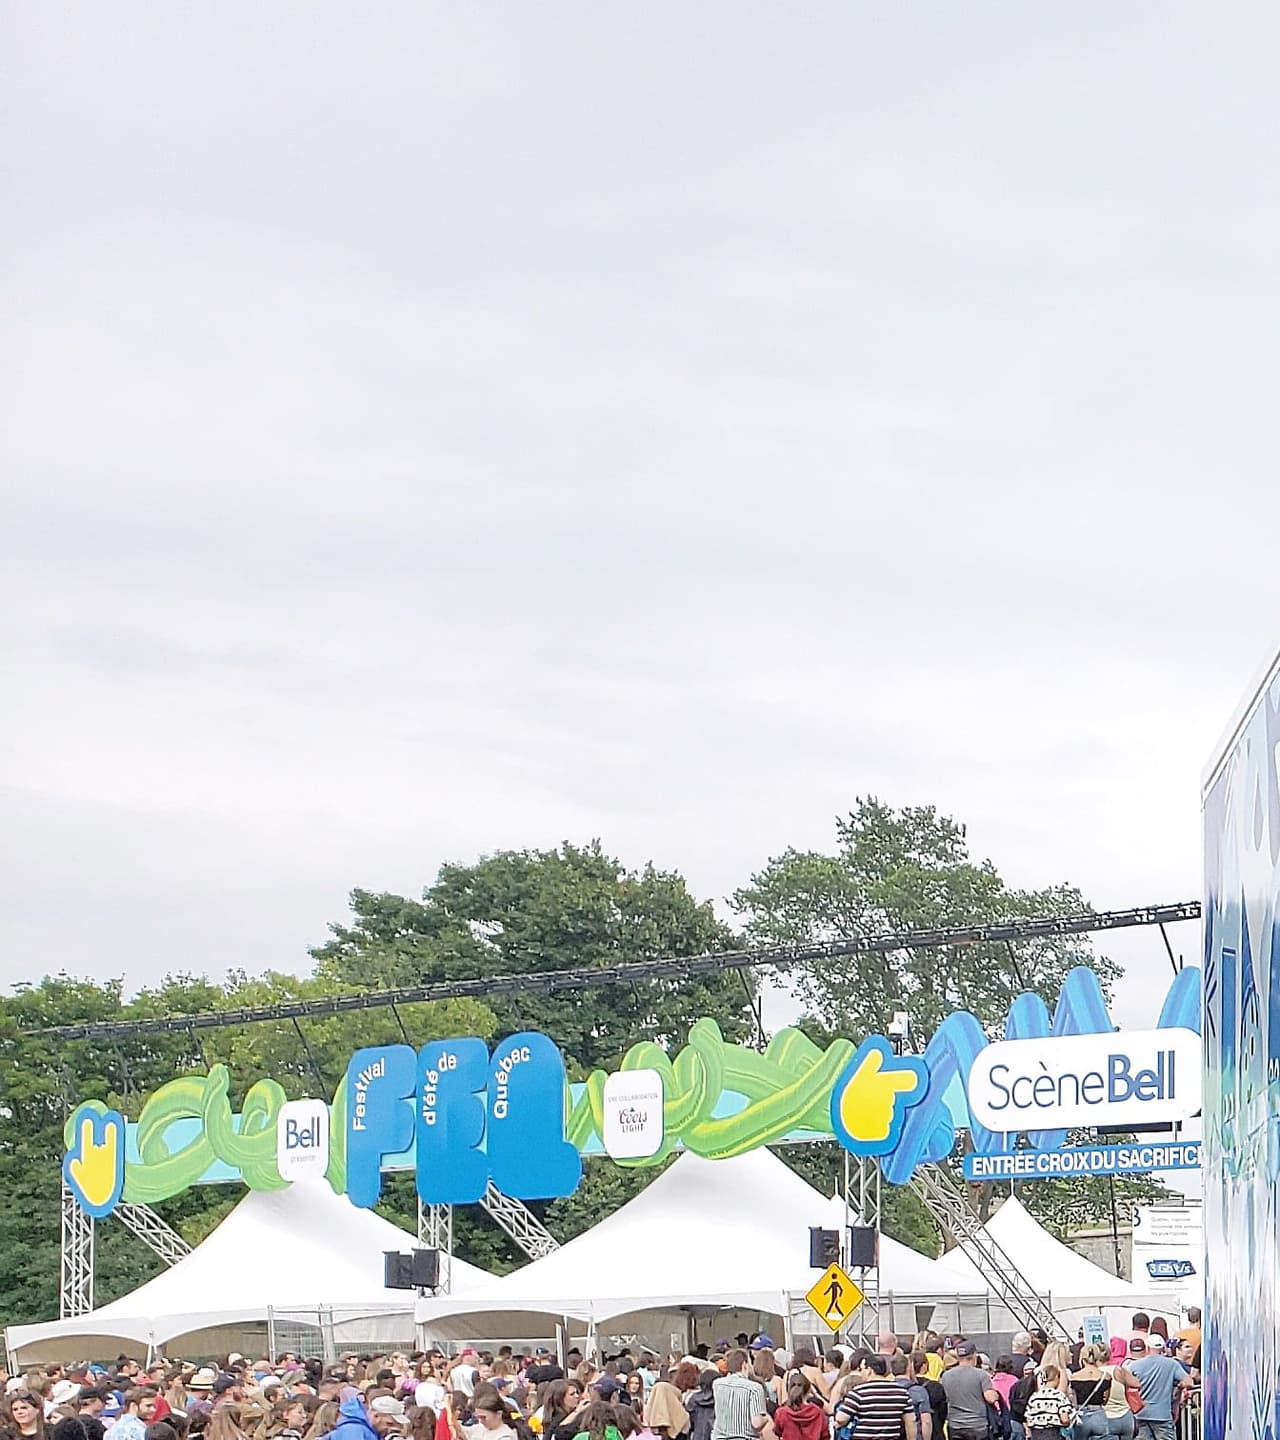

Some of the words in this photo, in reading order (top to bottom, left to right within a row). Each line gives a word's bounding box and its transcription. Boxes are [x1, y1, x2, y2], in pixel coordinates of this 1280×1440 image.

[352, 1057, 386, 1131] Festival
[422, 1068, 439, 1126] d'été
[438, 1052, 457, 1073] de
[493, 1046, 532, 1119] Québec
[286, 1117, 321, 1150] Bell
[972, 1151, 1036, 1176] ENTRÉE
[1037, 1151, 1091, 1171] CROIX
[1090, 1150, 1116, 1169] DU
[1117, 1145, 1202, 1168] SACRIFIC
